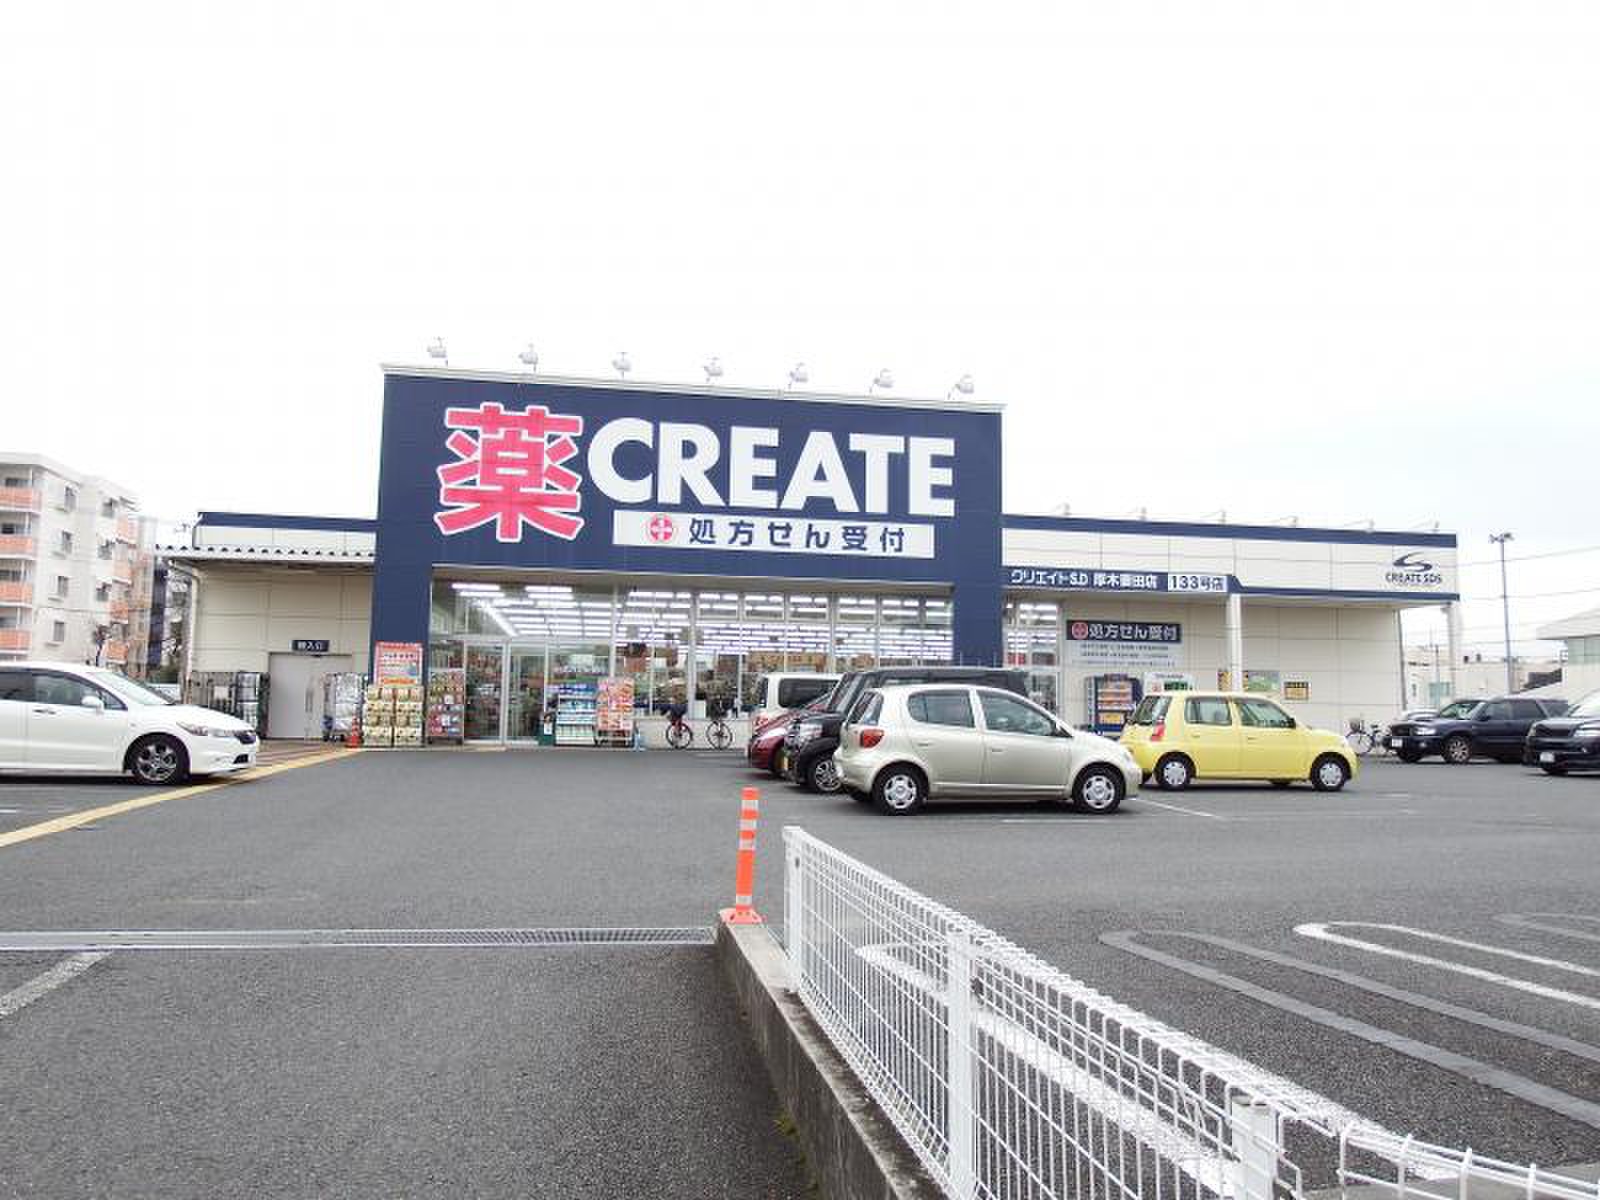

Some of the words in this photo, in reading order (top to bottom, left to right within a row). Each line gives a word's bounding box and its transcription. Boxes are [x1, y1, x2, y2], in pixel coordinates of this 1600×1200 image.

[434, 402, 584, 542] 薬
[588, 417, 955, 517] CREATE
[689, 517, 905, 553] 処方せん受付
[1385, 573, 1421, 584] CREATE
[1088, 623, 1178, 640] 処方せん受付
